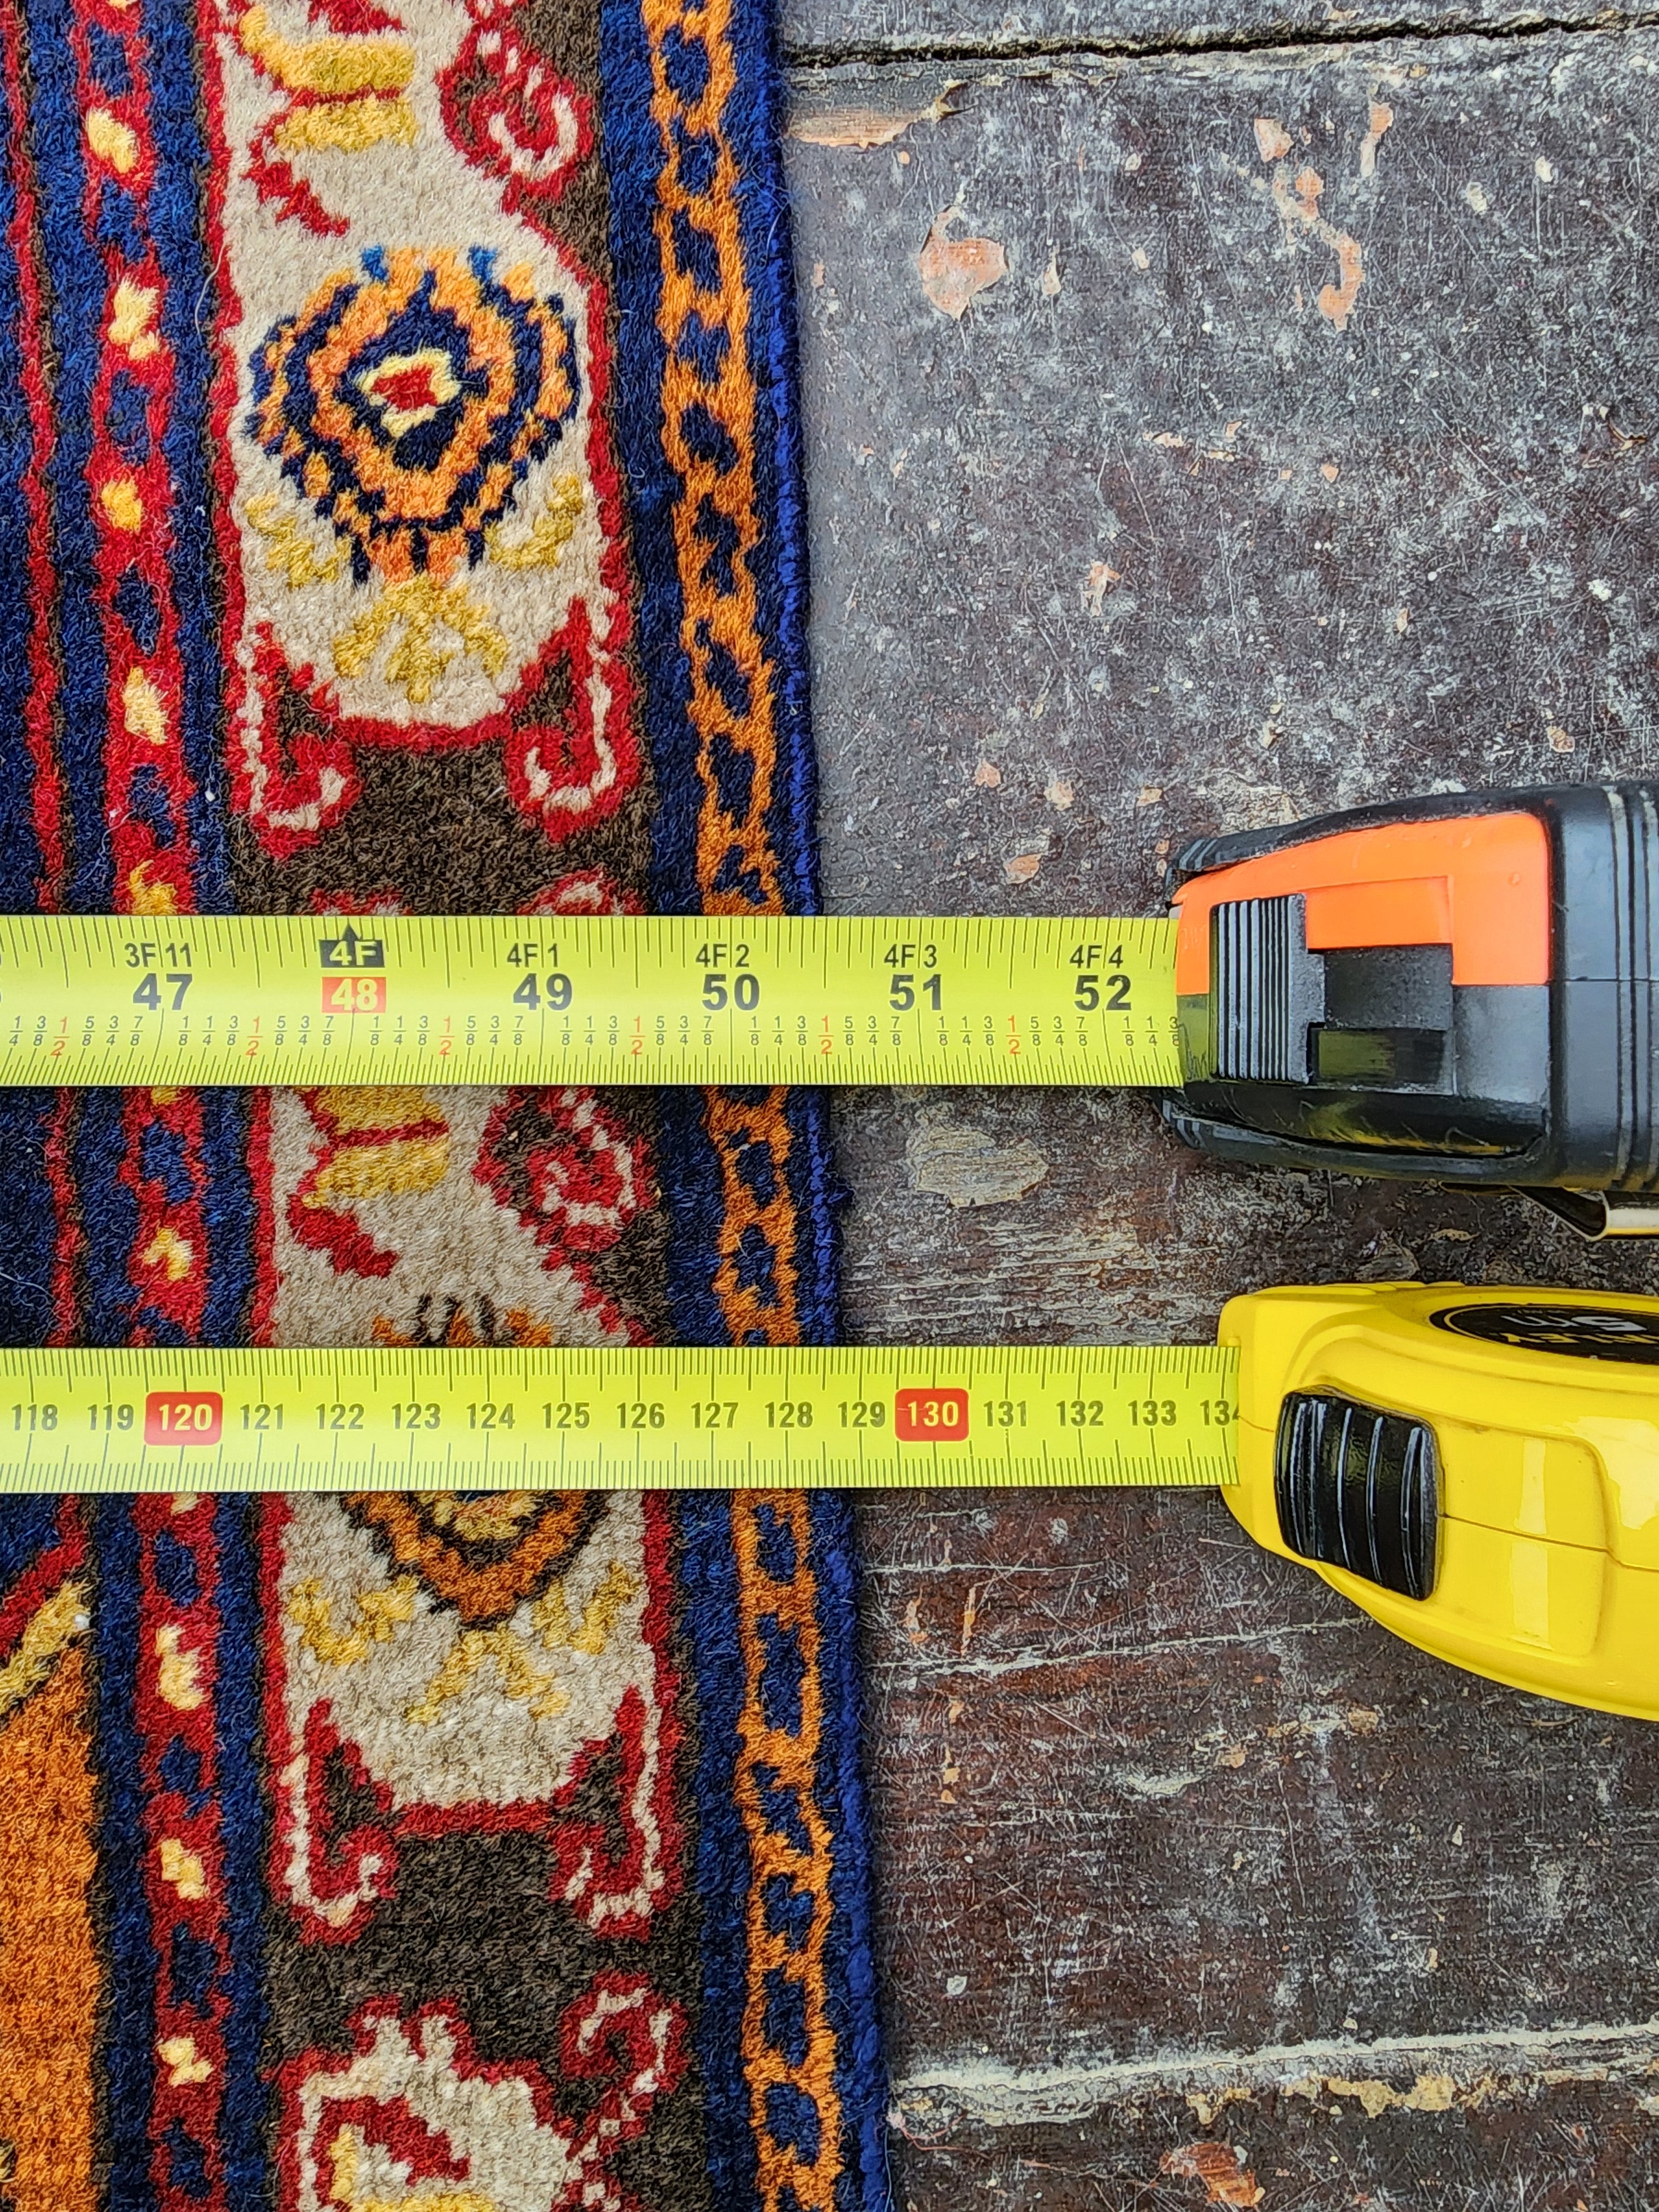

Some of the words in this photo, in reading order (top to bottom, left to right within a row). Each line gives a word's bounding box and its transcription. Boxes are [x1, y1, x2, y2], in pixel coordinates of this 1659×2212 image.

[329, 941, 377, 965] 4F
[133, 973, 194, 1010] 47
[331, 978, 378, 1011] 48
[513, 973, 572, 1010] 49
[702, 973, 760, 1011] 50
[889, 974, 942, 1011] 51
[1074, 974, 1131, 1011] 52
[12, 1404, 58, 1431] 118
[87, 1404, 134, 1431] 119
[159, 1404, 213, 1431] 120
[239, 1403, 284, 1430] 121
[315, 1403, 365, 1430] 122
[391, 1402, 441, 1430] 123
[466, 1402, 516, 1429] 124
[541, 1402, 590, 1429] 125
[616, 1402, 665, 1428] 126
[691, 1401, 739, 1428] 127
[764, 1401, 813, 1428] 128
[837, 1401, 886, 1428] 129
[907, 1400, 959, 1427] 130
[983, 1400, 1027, 1427] 131
[1056, 1400, 1104, 1426] 132
[1128, 1400, 1177, 1426] 133
